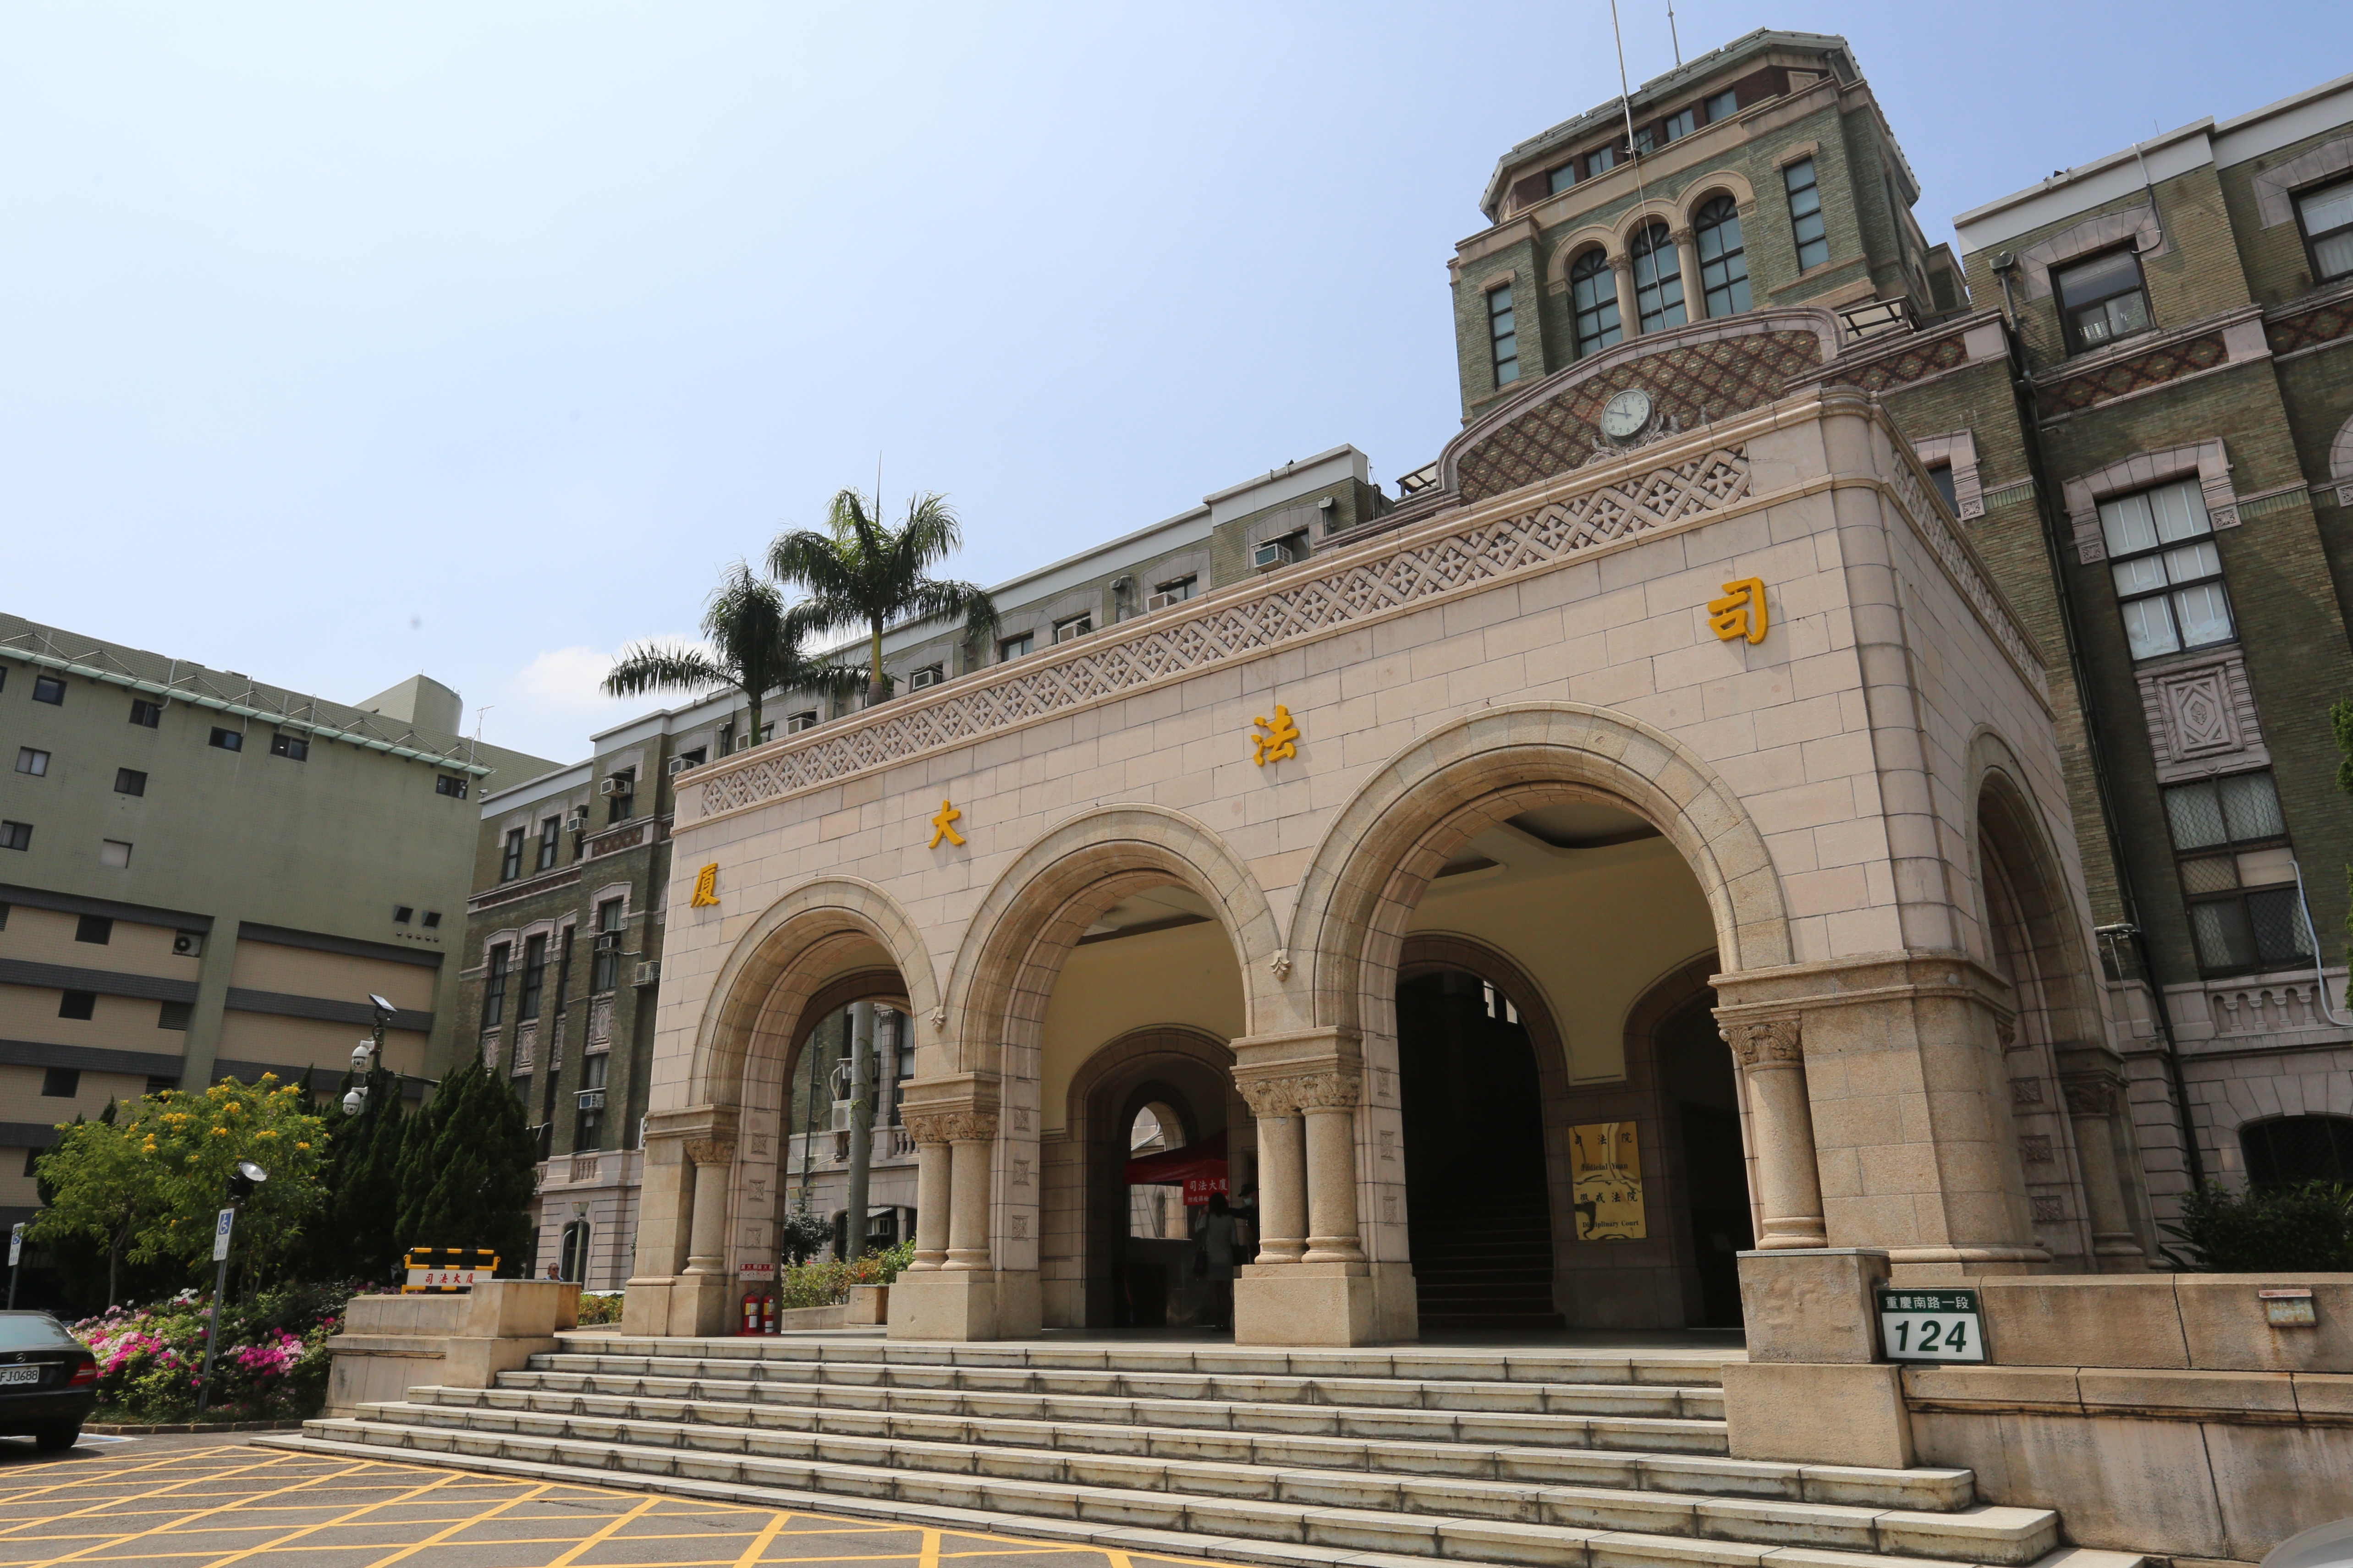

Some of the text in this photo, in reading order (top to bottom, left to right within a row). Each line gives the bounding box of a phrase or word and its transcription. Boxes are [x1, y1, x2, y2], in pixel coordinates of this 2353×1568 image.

[1886, 1296, 1969, 1309] 重慶南路一段
[1896, 1320, 1966, 1352] 124
